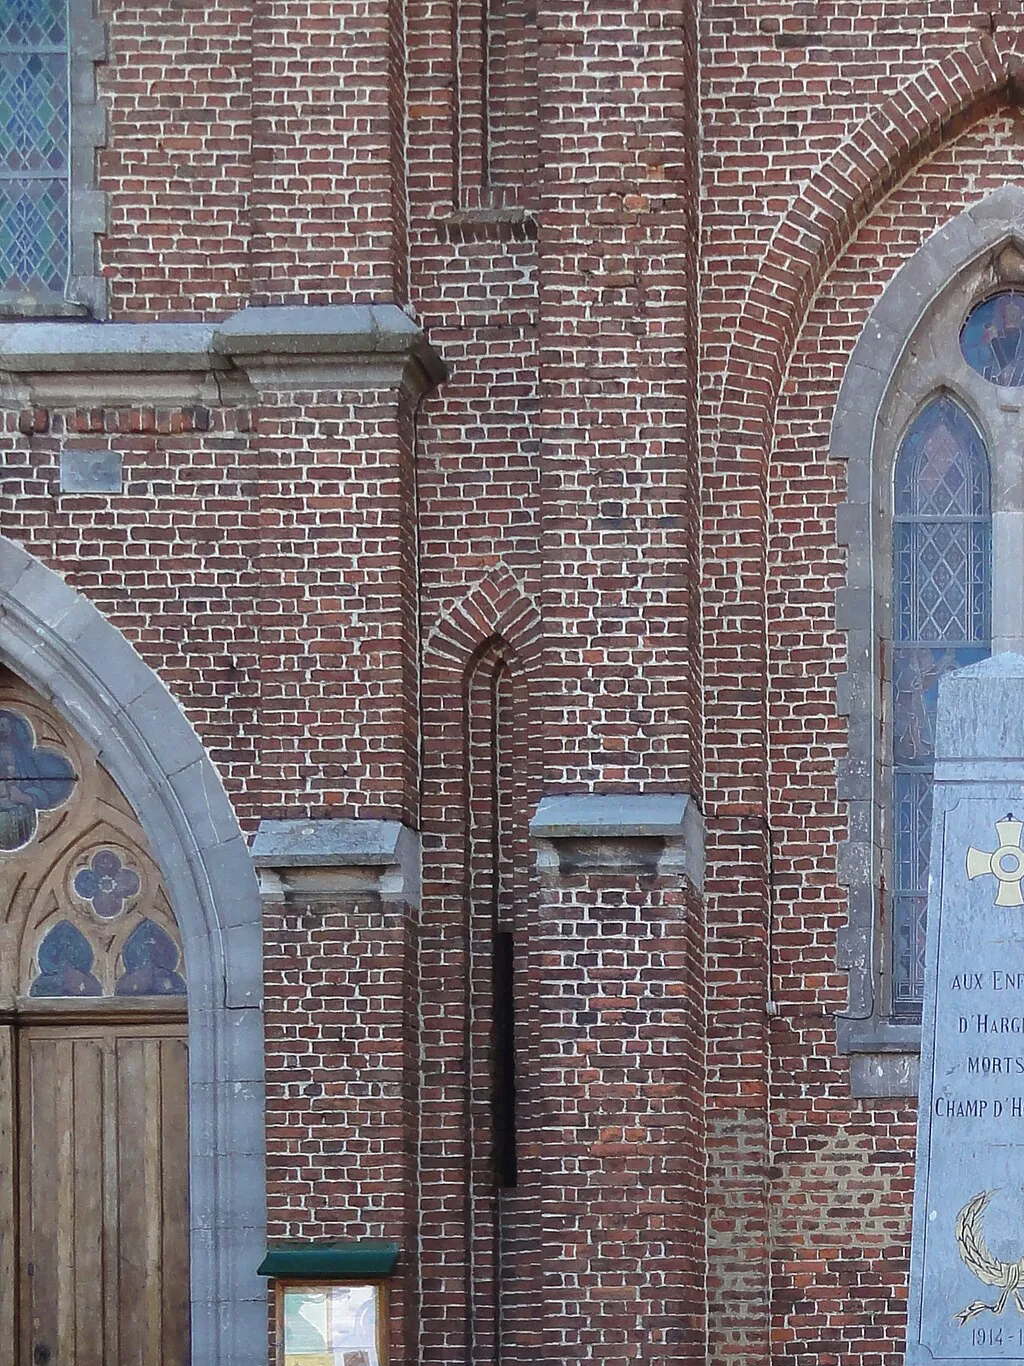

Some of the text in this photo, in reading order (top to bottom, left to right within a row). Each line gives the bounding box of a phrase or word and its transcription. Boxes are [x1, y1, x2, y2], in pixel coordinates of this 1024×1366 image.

[952, 974, 983, 990] AUX
[967, 1057, 1024, 1075] MORTS
[935, 1097, 988, 1118] CHAMP
